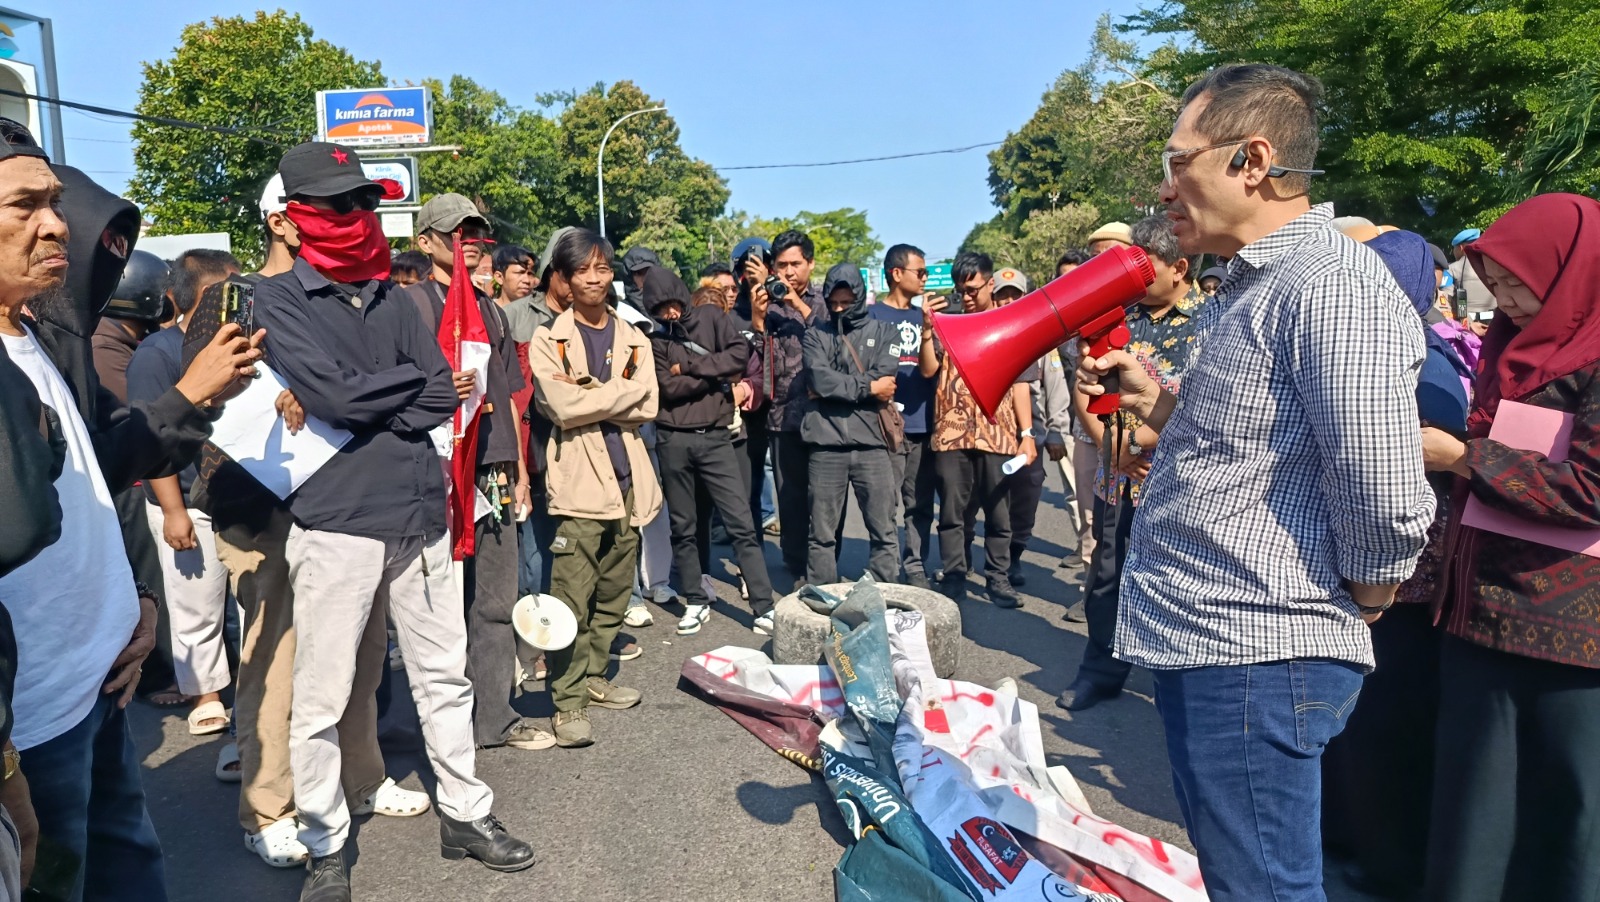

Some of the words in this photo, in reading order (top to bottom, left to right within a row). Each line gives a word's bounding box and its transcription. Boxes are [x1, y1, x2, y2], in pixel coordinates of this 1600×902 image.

[335, 108, 371, 120] kimia
[374, 106, 415, 118] farma
[358, 123, 393, 133] Apotek
[839, 654, 858, 684] Lembaga
